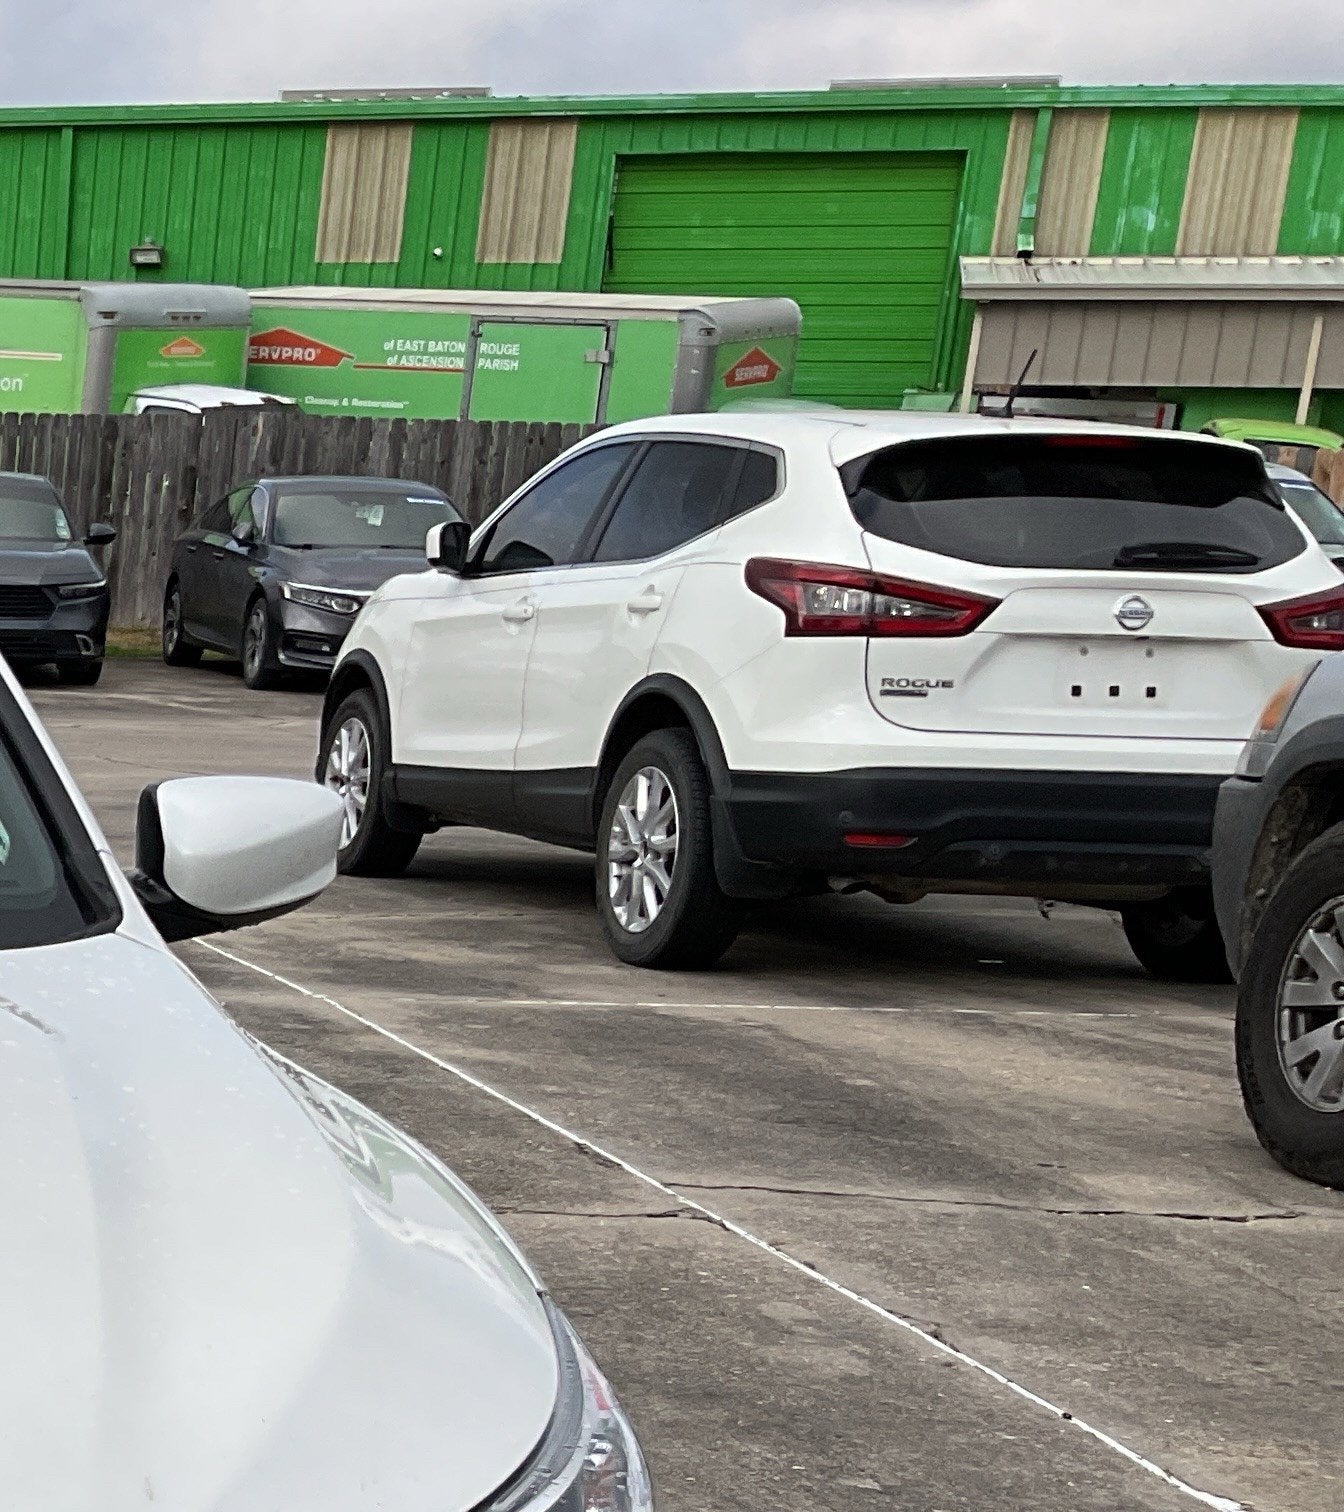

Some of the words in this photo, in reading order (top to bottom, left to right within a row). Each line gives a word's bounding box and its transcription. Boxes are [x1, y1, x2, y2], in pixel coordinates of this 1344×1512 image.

[249, 345, 317, 362] ERVPRO
[383, 340, 395, 350] of
[397, 340, 425, 352] EAST
[427, 341, 466, 353] BATON
[479, 343, 520, 356] ROUGE
[400, 355, 464, 368] ASCENSION
[477, 358, 519, 371] PARISH
[880, 677, 954, 689] ROGUE
